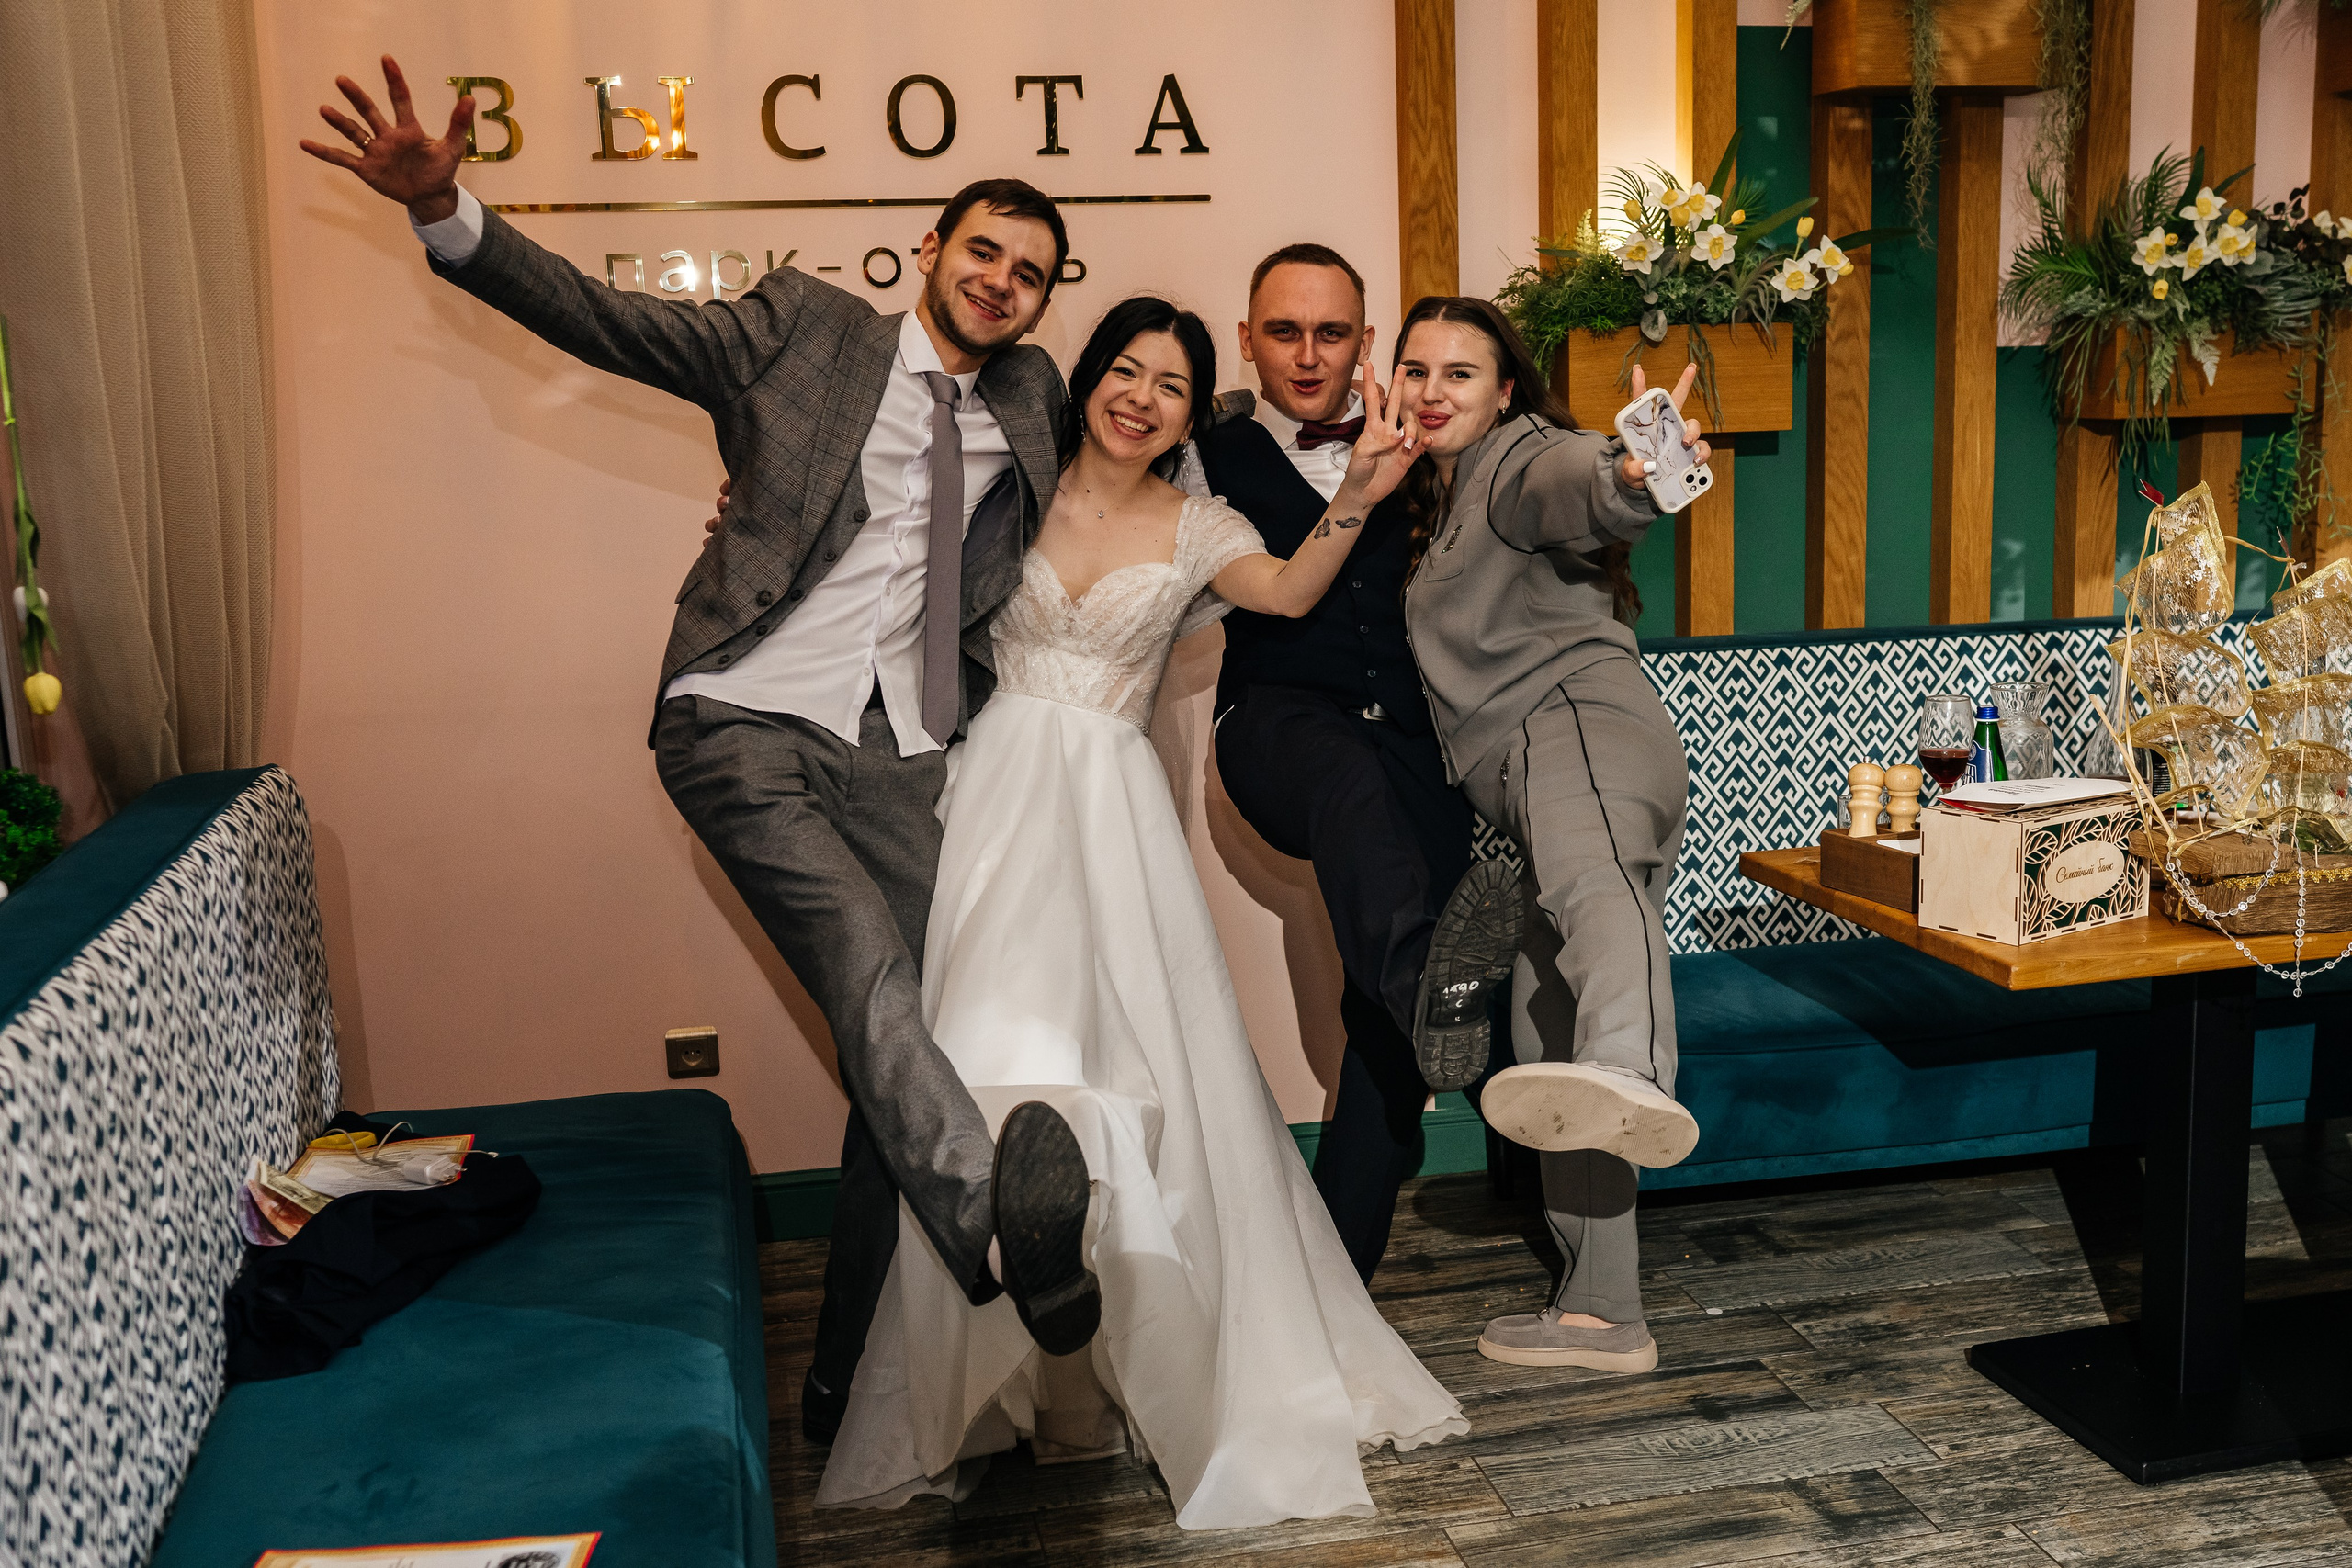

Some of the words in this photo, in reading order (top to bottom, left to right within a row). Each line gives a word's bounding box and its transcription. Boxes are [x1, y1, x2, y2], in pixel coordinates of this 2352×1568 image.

[446, 73, 1210, 161] ВЫСОТА
[2055, 864, 2095, 884] Семейный
[2097, 857, 2114, 874] банк
